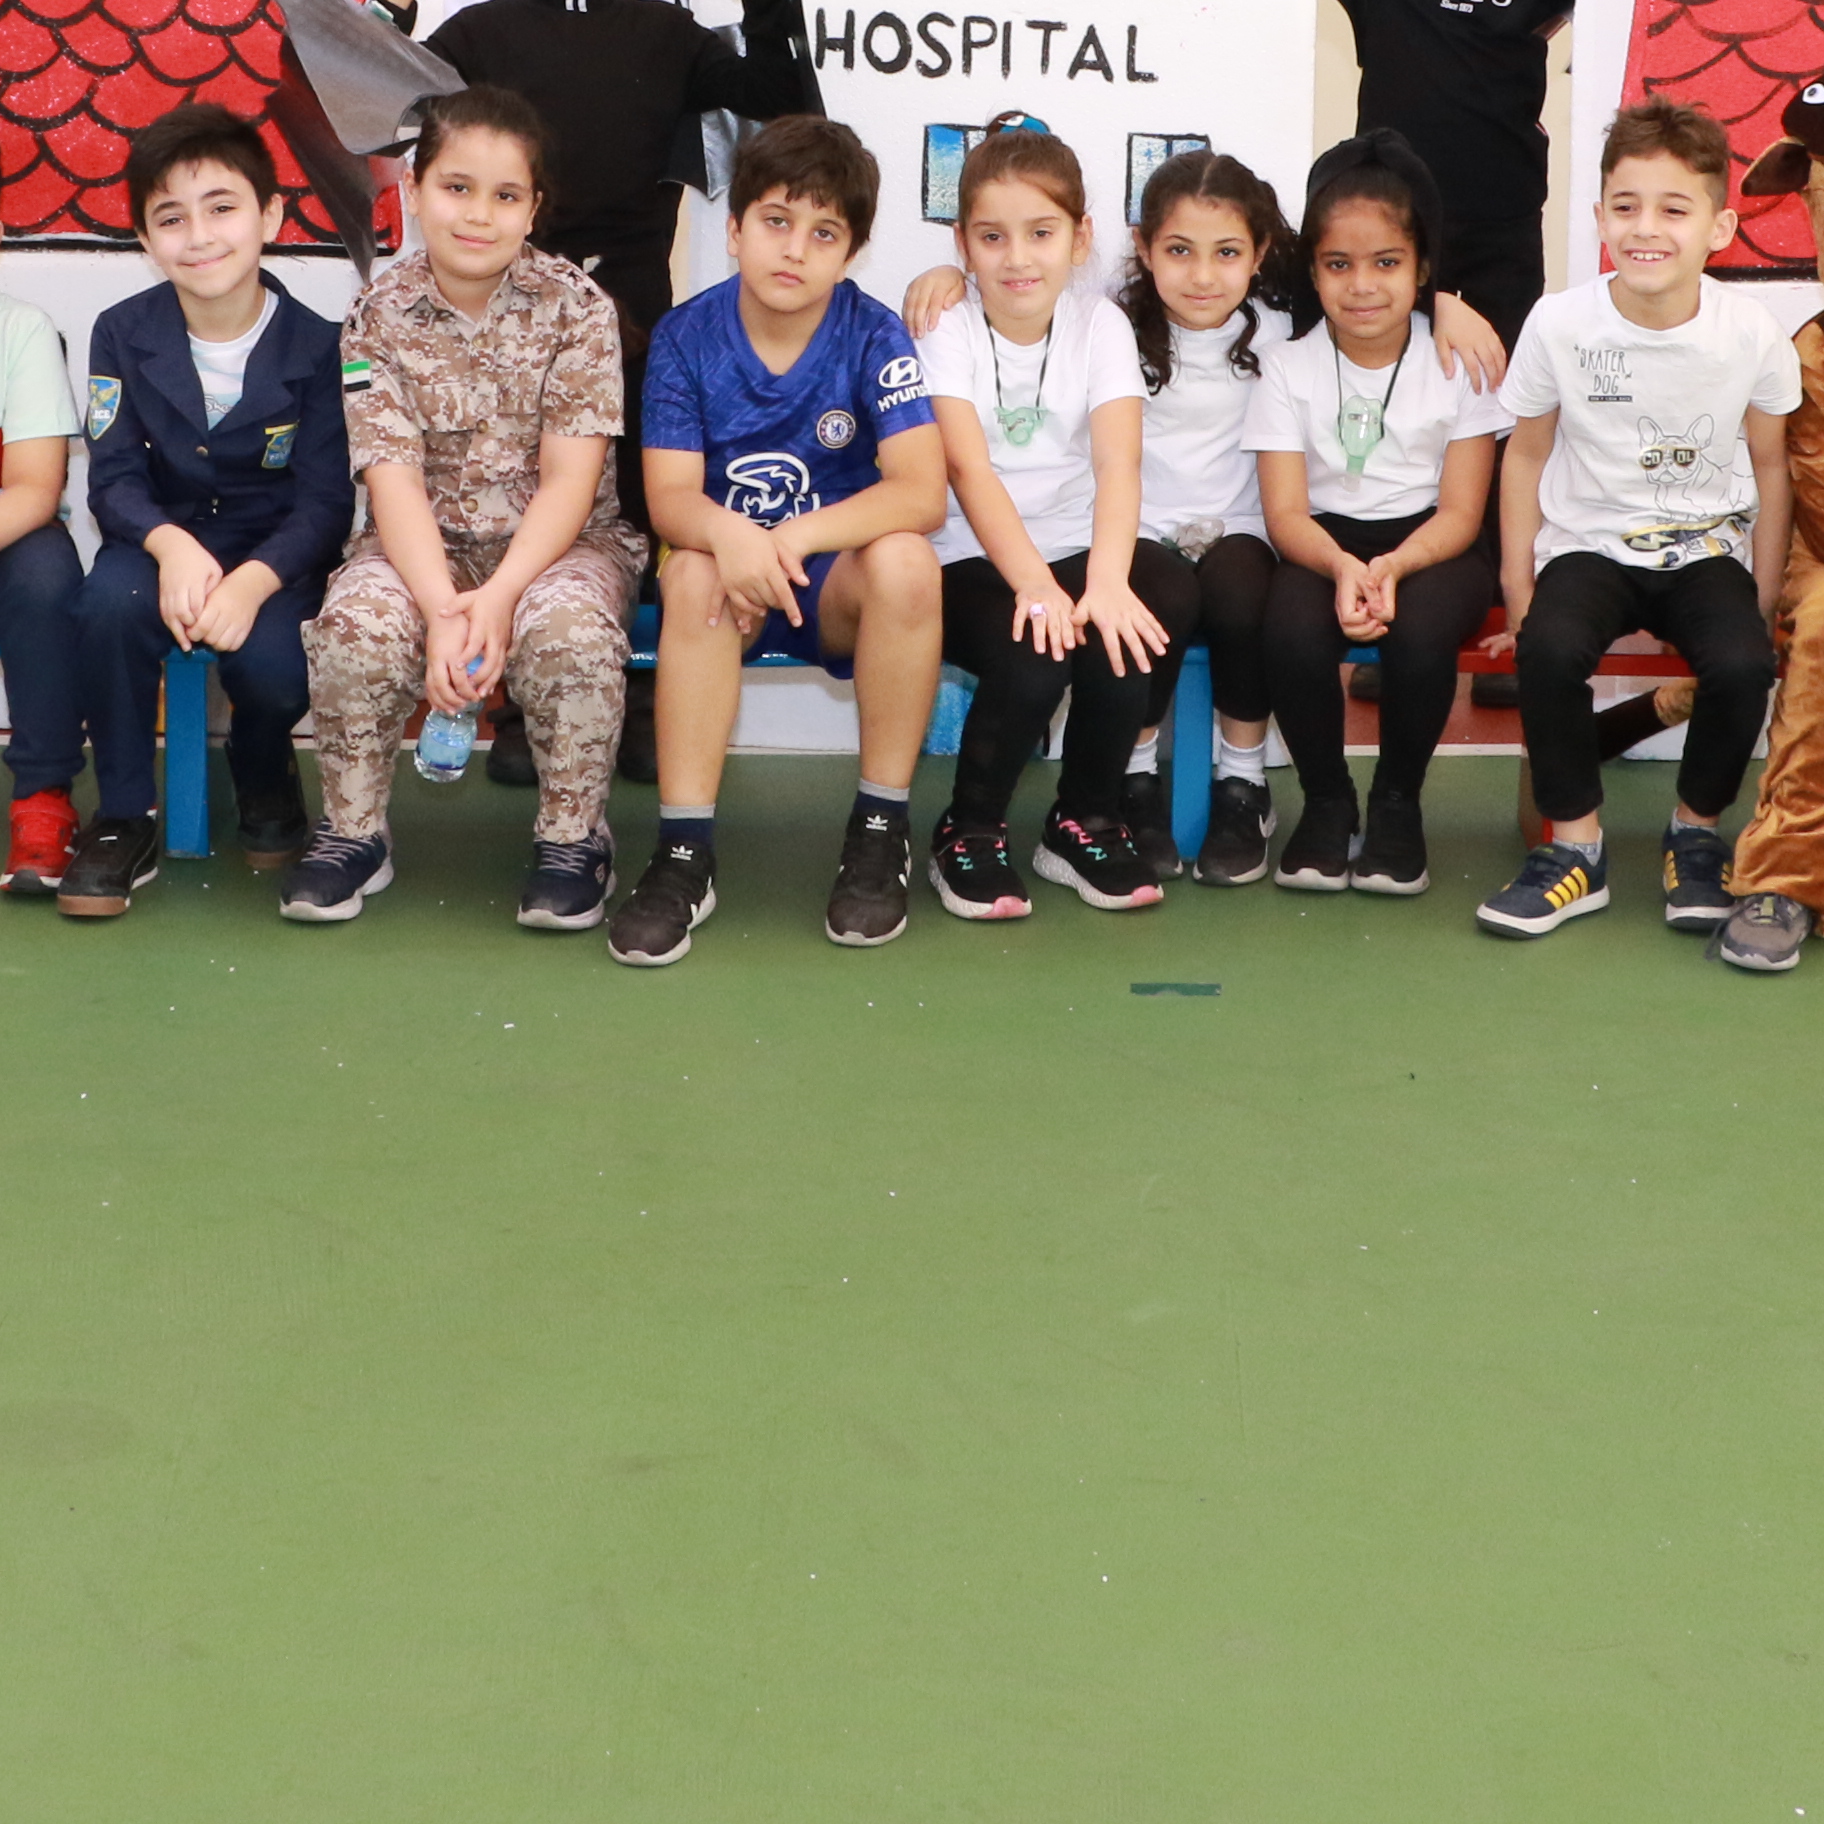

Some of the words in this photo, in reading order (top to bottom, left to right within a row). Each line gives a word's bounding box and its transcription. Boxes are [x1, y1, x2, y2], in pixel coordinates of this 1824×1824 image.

[814, 6, 1159, 83] HOSPITAL
[1580, 348, 1626, 373] SKATER
[1593, 374, 1619, 395] DOG
